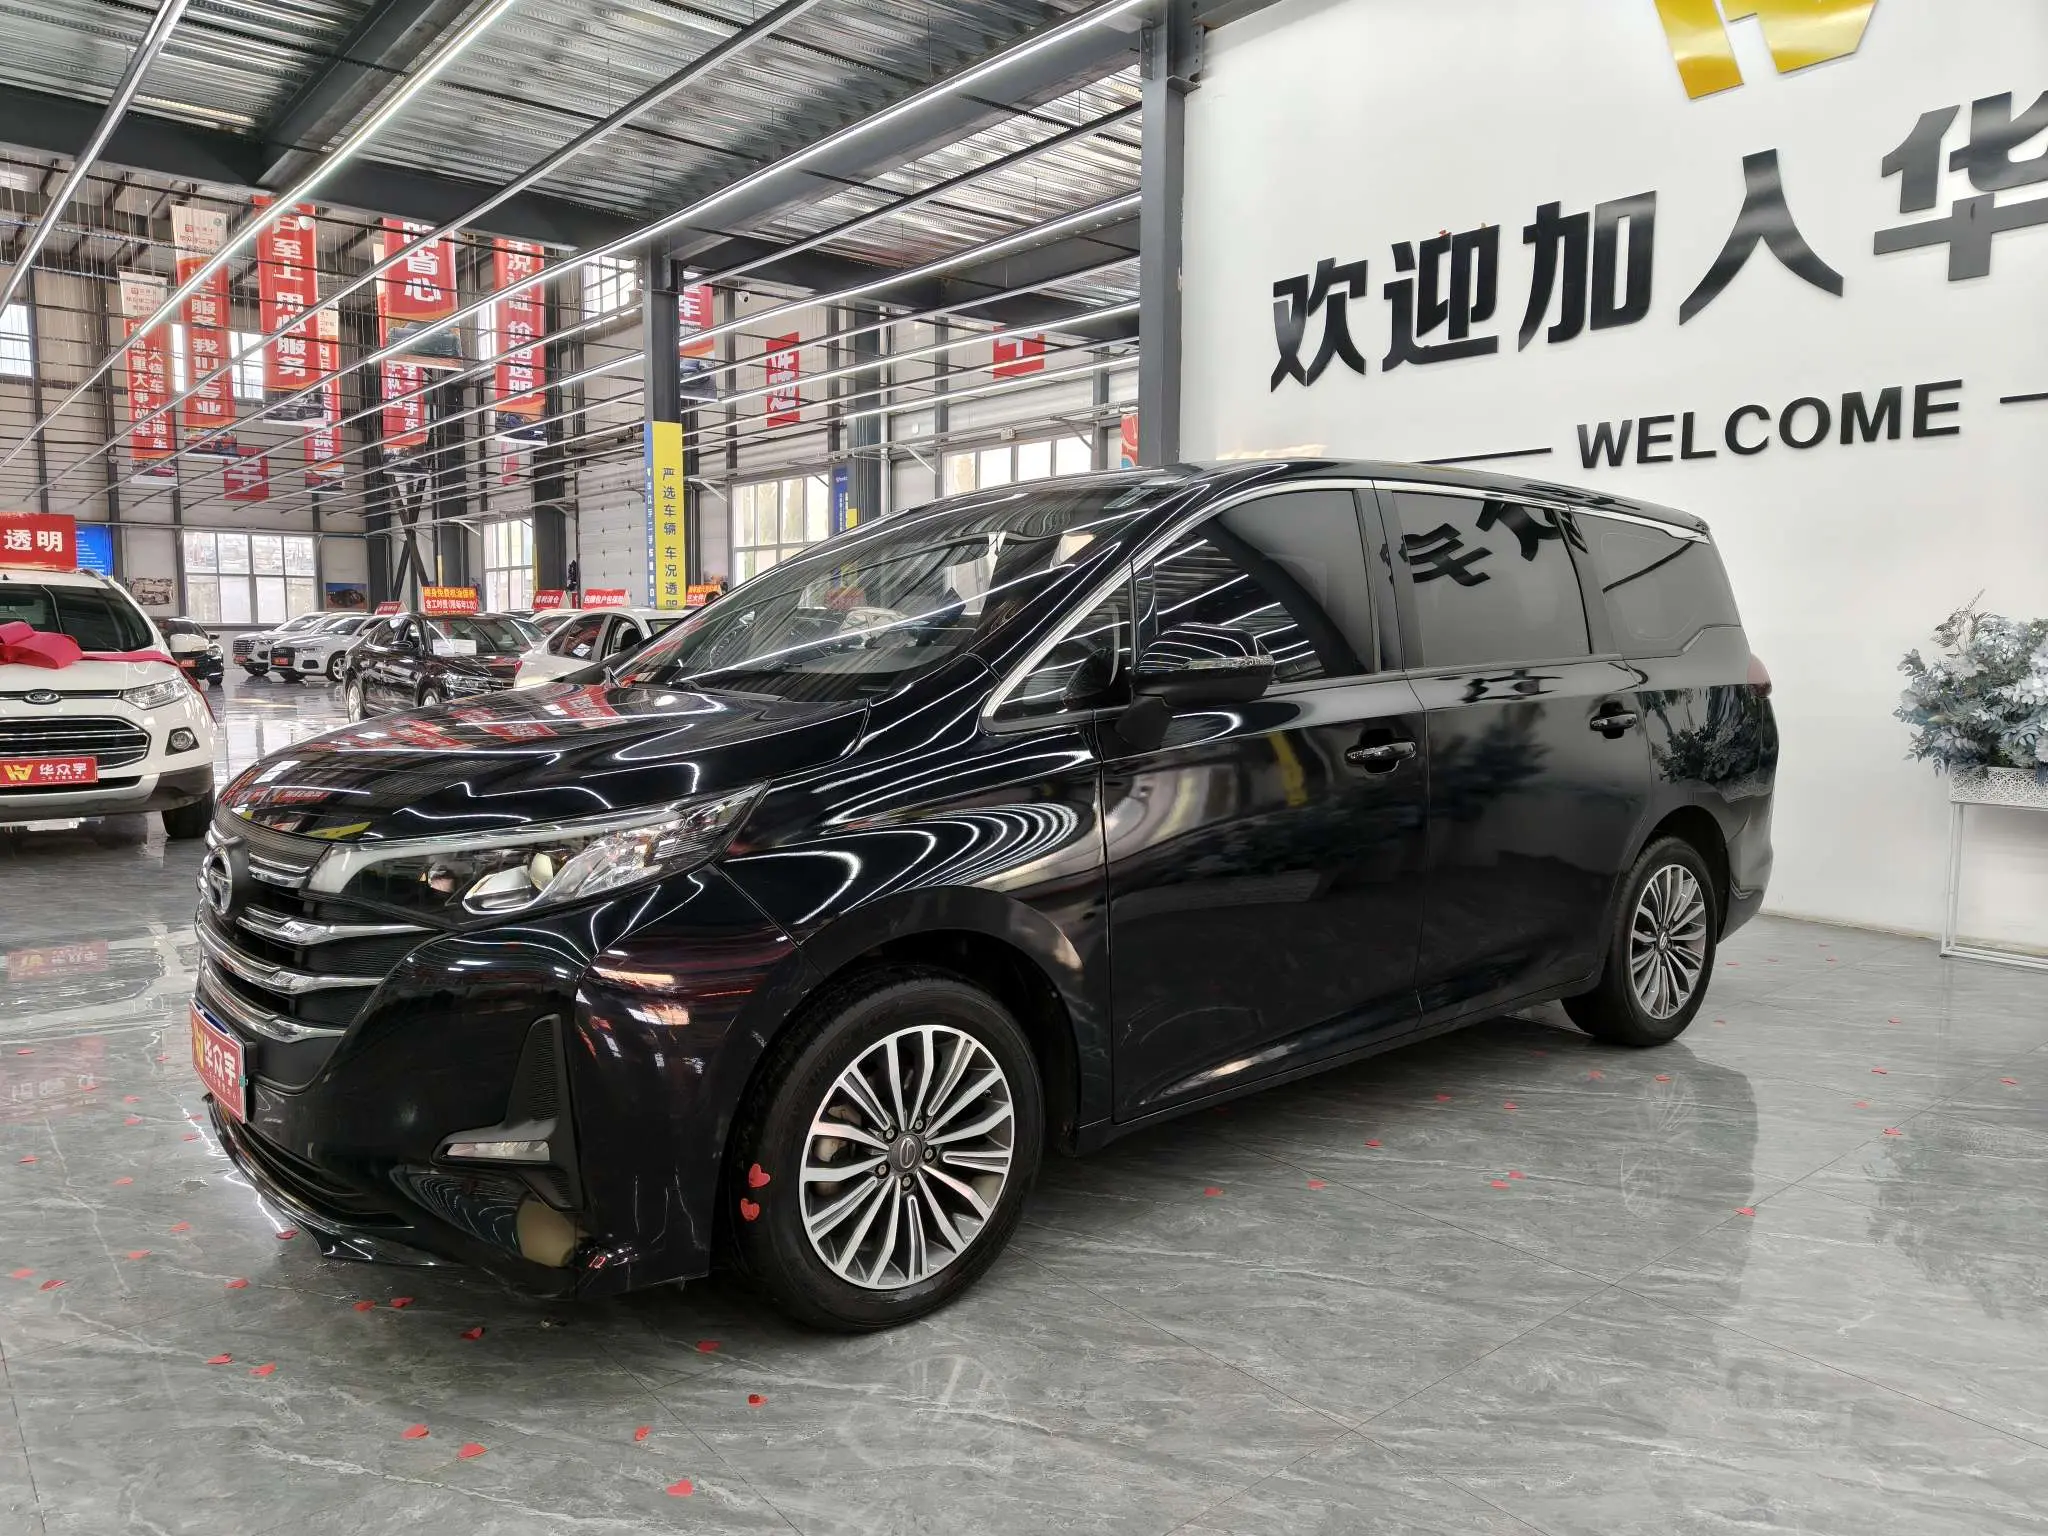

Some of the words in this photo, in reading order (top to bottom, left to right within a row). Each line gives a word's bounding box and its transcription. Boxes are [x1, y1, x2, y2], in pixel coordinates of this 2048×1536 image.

[1577, 379, 1964, 470] WELCOME
[662, 467, 677, 536] 严选车辆
[4, 529, 63, 552] 透明
[39, 762, 87, 776] 华众宇
[203, 1032, 237, 1087] 华众宇
